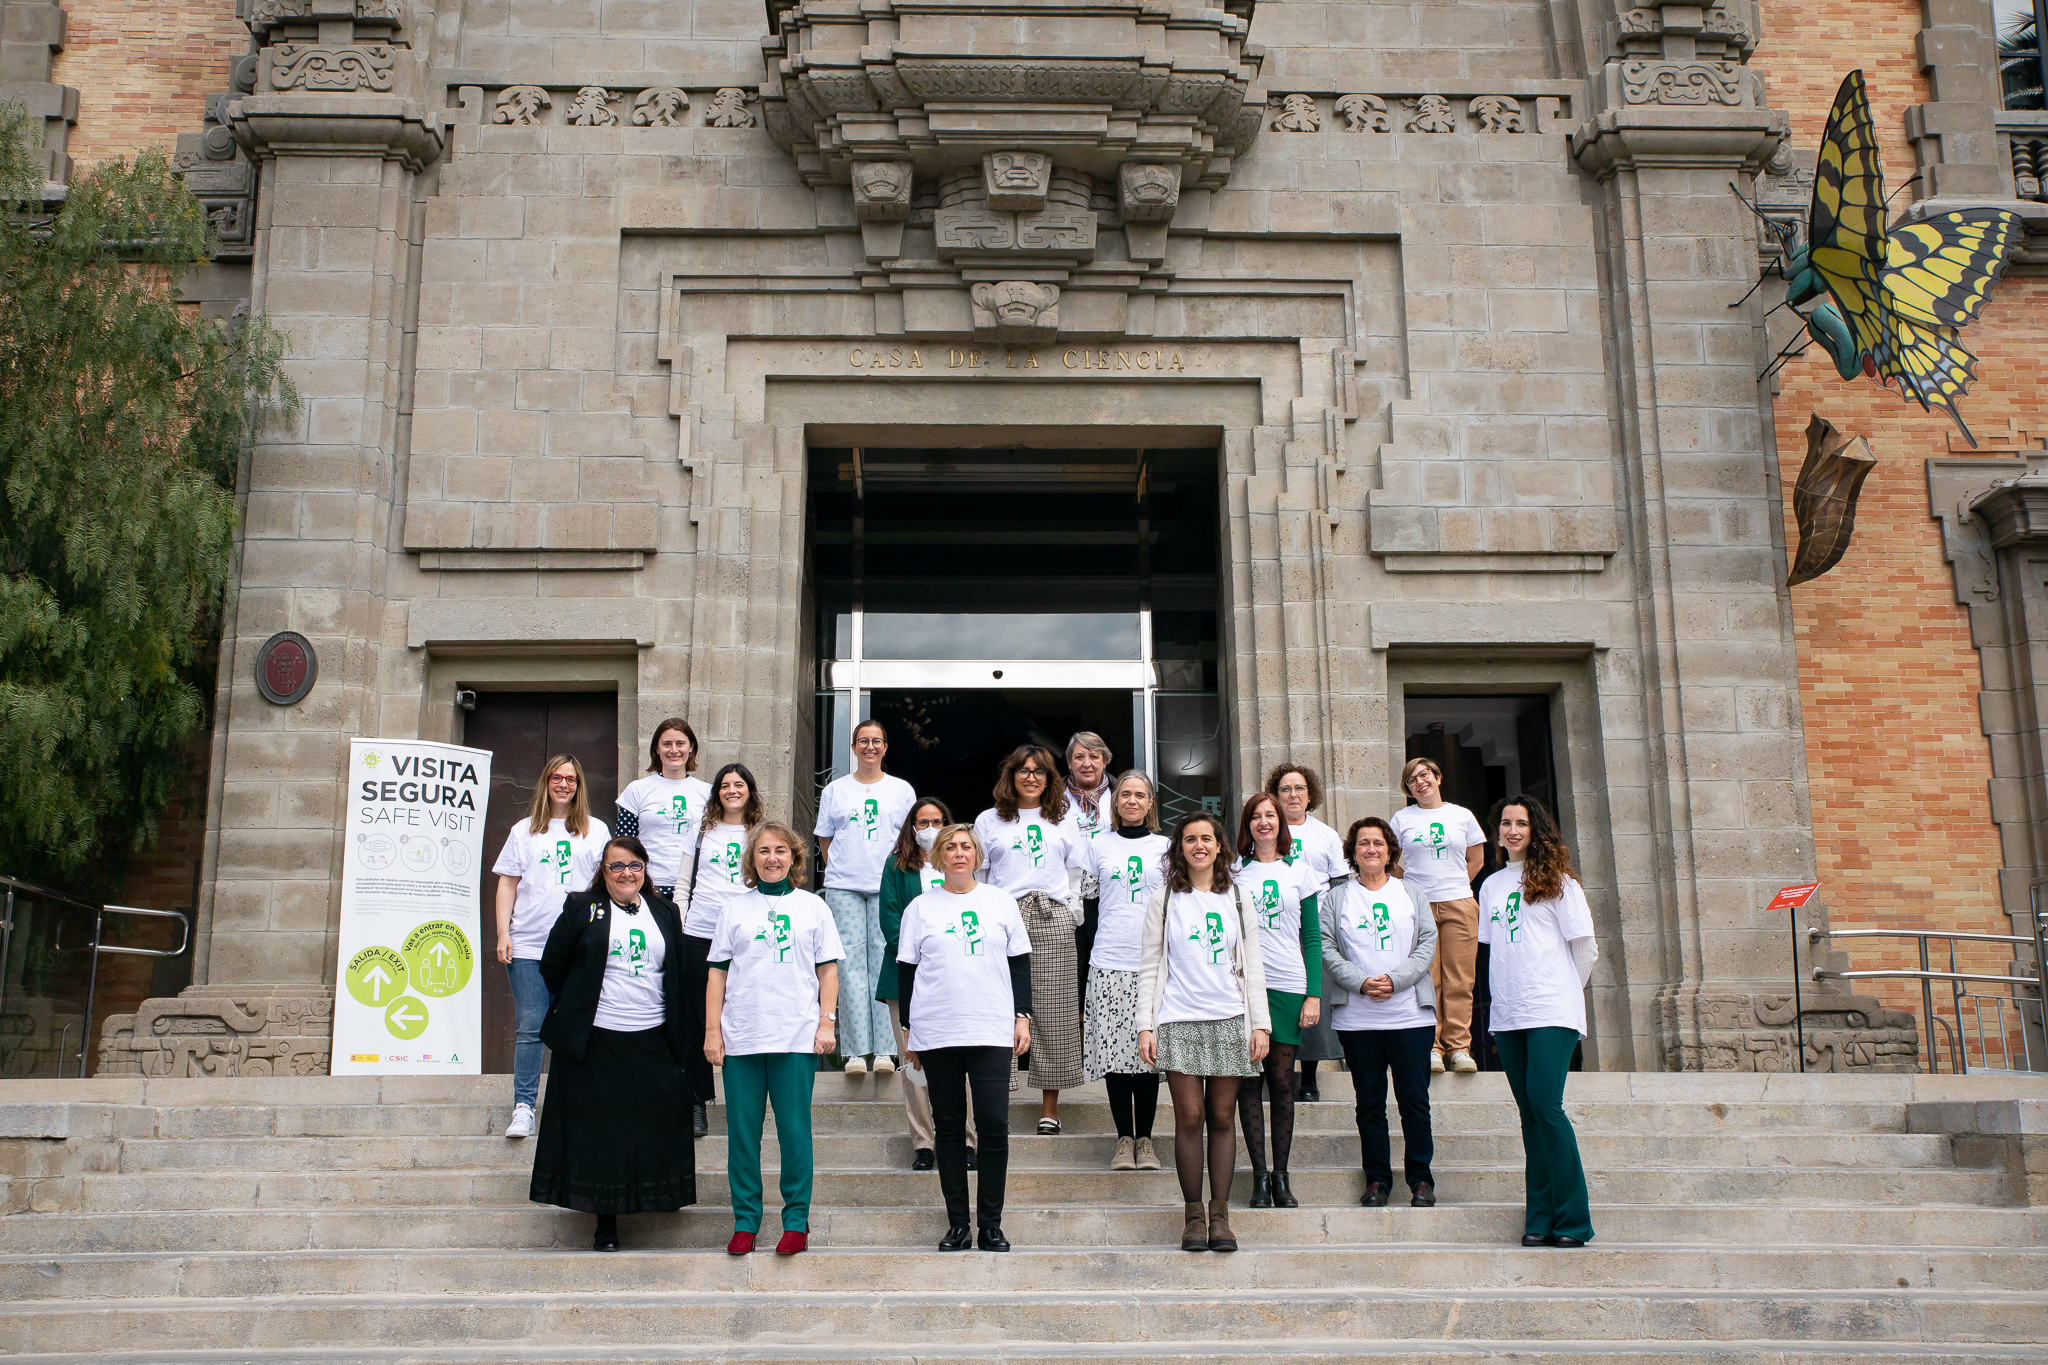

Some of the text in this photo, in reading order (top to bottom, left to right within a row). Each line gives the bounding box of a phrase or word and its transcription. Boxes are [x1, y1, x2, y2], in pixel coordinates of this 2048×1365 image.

[849, 348, 1185, 370] CASA DE LA CIENCIA
[391, 755, 479, 785] VISITA
[361, 780, 475, 811] SEGURA
[360, 807, 476, 833] SAFE VISIT
[404, 938, 415, 952] Vas
[419, 923, 443, 934] entrar
[445, 924, 455, 932] en
[455, 929, 465, 943] una
[463, 944, 471, 960] sala
[350, 949, 381, 971] SALIDA
[381, 950, 389, 958] /
[388, 953, 405, 972] EXIT
